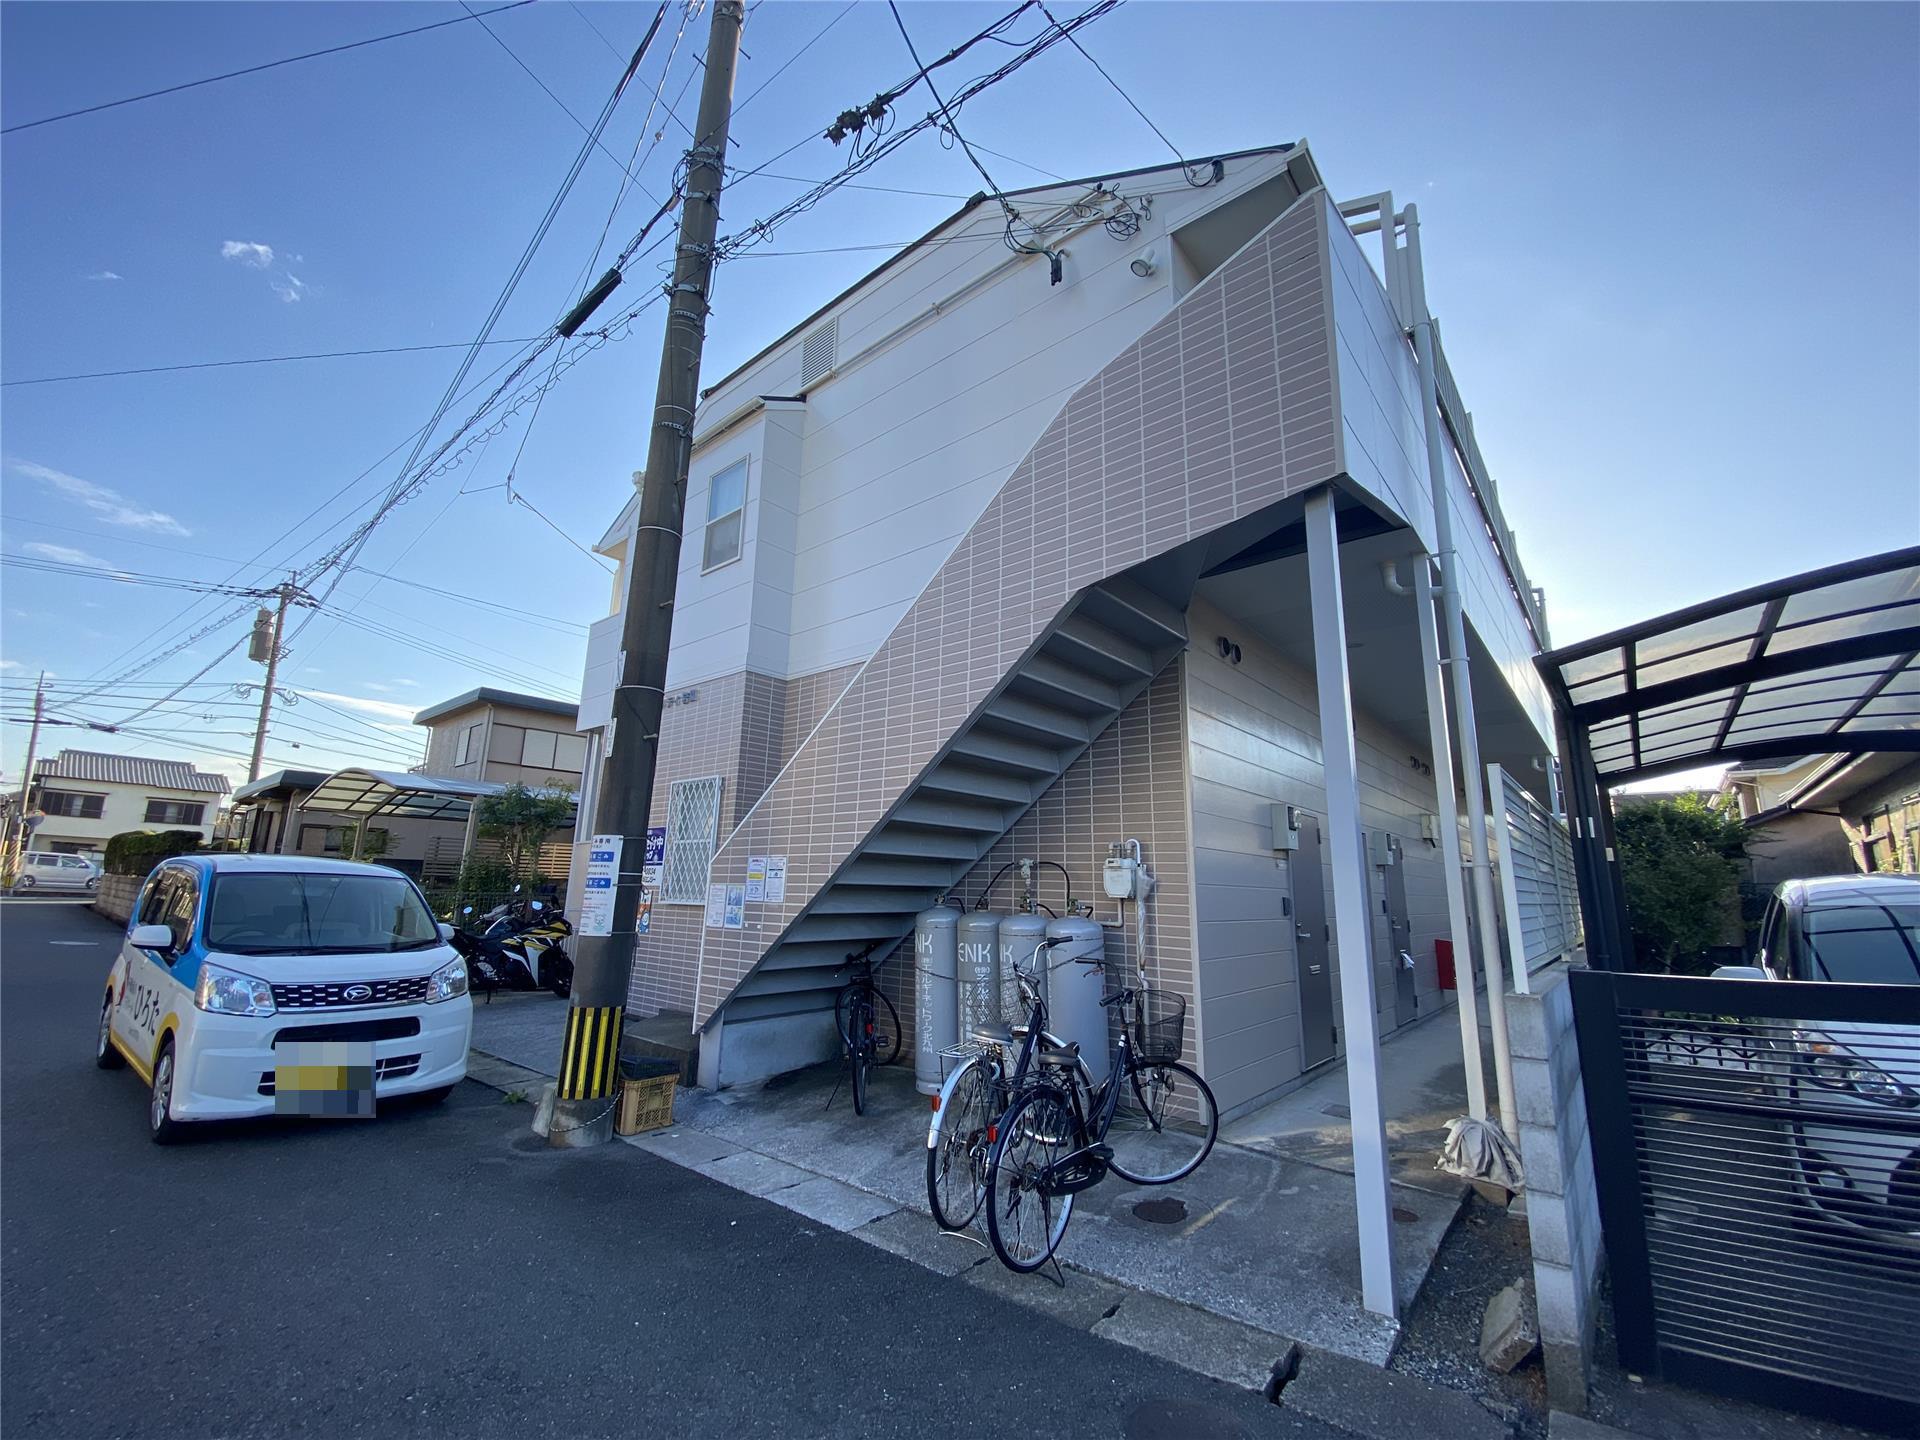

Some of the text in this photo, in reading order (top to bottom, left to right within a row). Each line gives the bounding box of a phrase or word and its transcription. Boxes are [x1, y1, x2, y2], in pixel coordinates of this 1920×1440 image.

[958, 943, 992, 963] ENK
[134, 985, 159, 1036] ひろた
